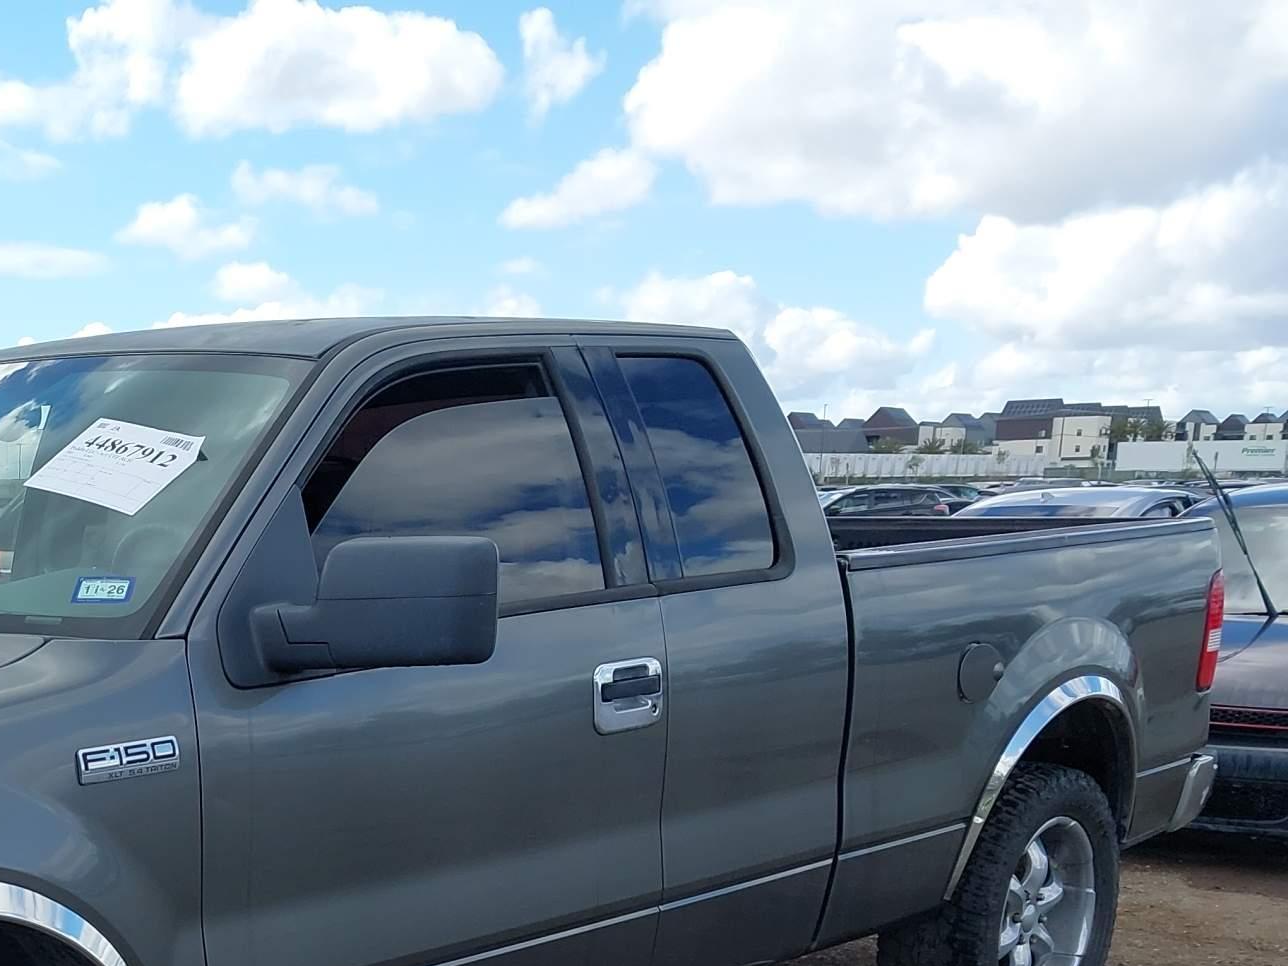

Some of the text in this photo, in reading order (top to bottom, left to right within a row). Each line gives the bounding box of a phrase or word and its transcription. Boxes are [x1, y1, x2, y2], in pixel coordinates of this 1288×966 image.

[84, 435, 178, 468] 44867912
[107, 584, 126, 595] 26
[81, 739, 177, 772] F-150
